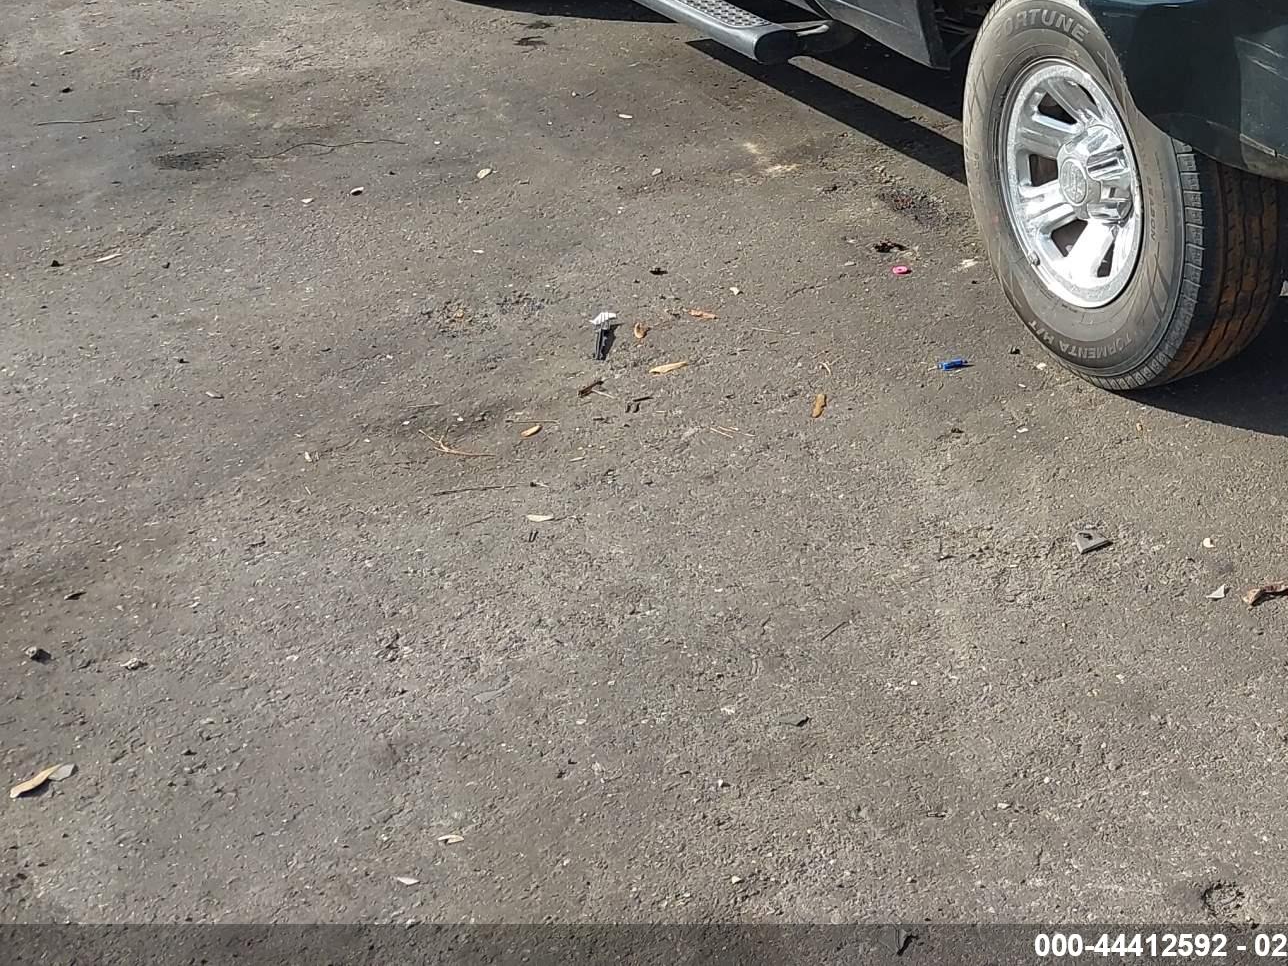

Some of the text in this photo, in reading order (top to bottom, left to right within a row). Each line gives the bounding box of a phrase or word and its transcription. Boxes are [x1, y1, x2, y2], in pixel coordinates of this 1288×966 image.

[993, 8, 1089, 42] FORTUNE
[1030, 320, 1133, 359] TORMENTA H/T
